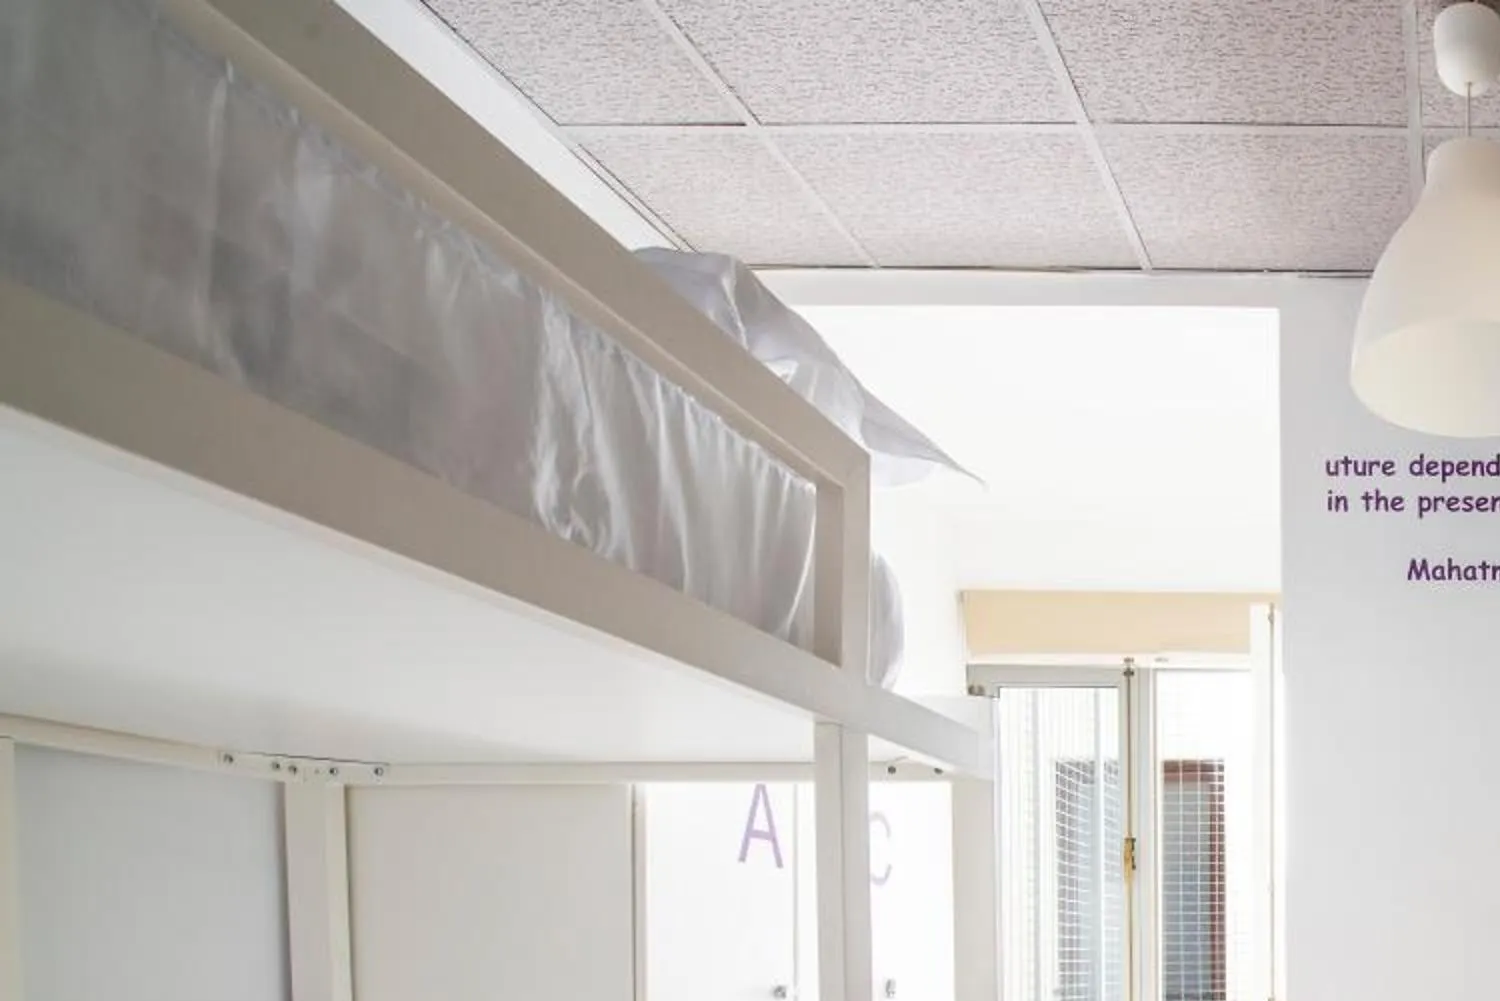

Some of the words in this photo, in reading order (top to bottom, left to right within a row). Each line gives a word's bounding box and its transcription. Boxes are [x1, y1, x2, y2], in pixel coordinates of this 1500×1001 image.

[1325, 456, 1396, 478] uture
[1327, 489, 1349, 513] in
[1360, 489, 1405, 513] the
[738, 783, 784, 869] A
